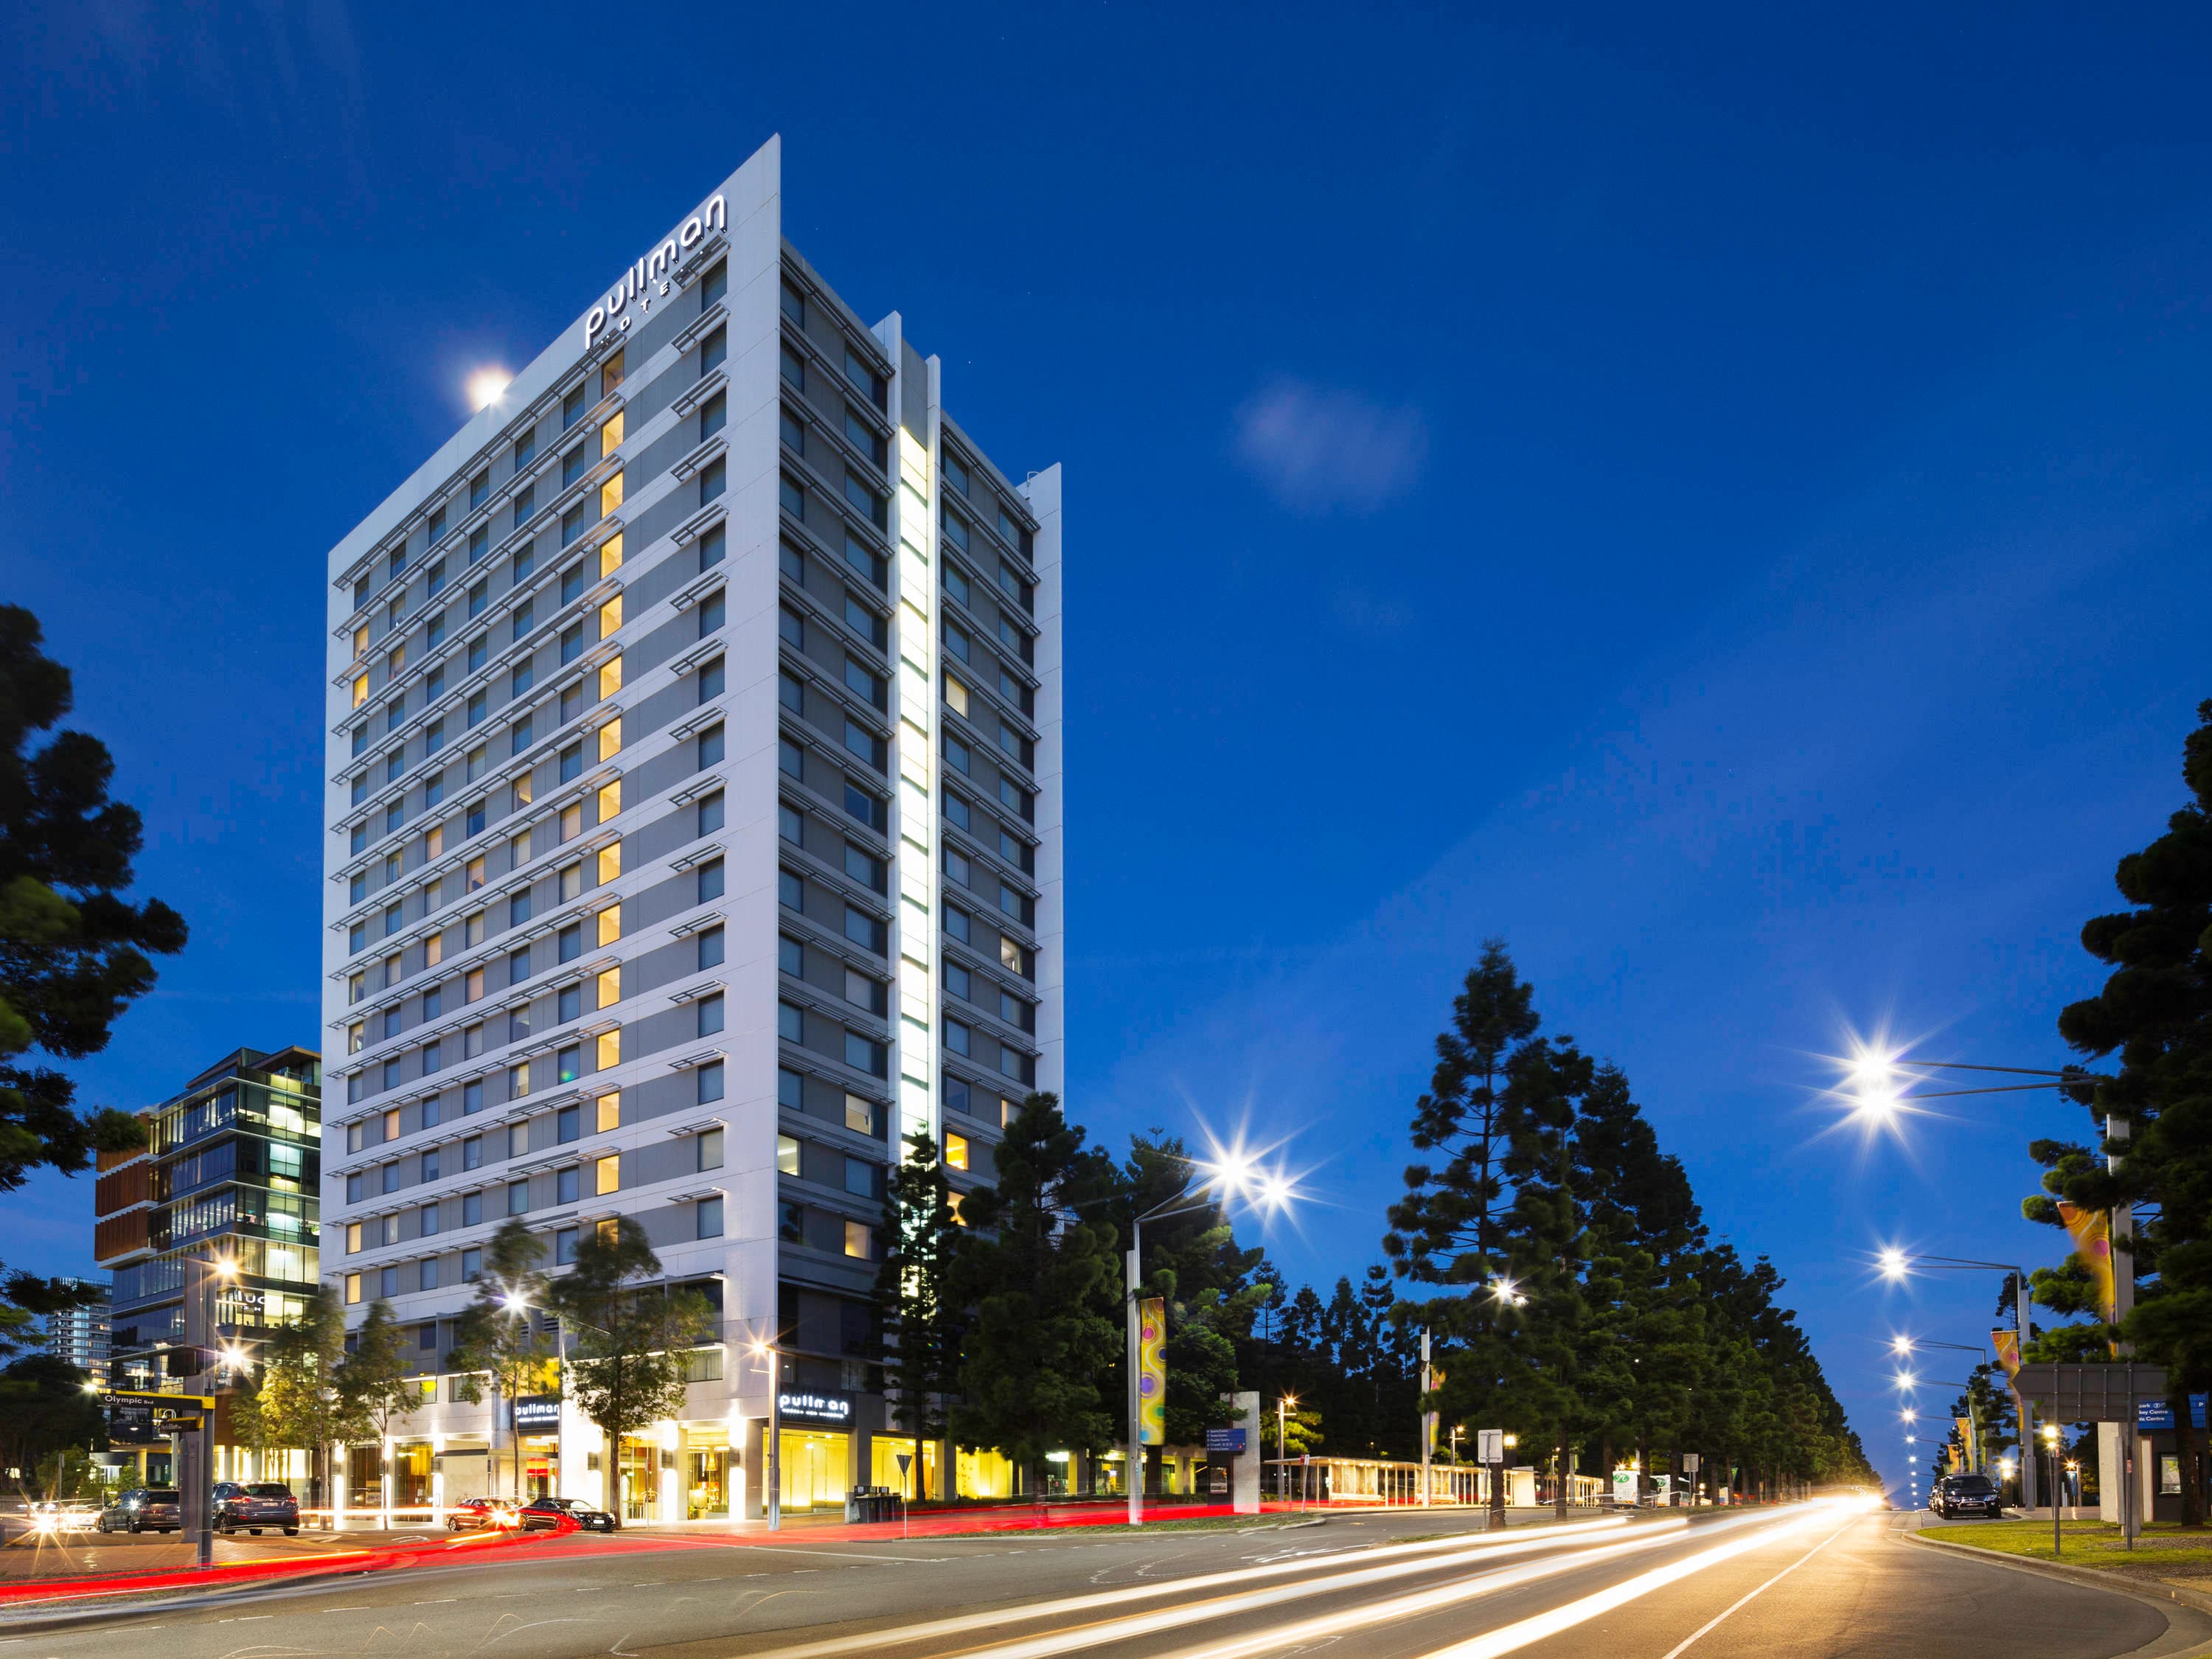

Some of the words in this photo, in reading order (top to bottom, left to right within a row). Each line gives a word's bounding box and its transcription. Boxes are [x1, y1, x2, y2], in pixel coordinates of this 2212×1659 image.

[585, 195, 728, 352] pullman
[105, 1395, 142, 1405] Olympic
[779, 1395, 849, 1415] pullman
